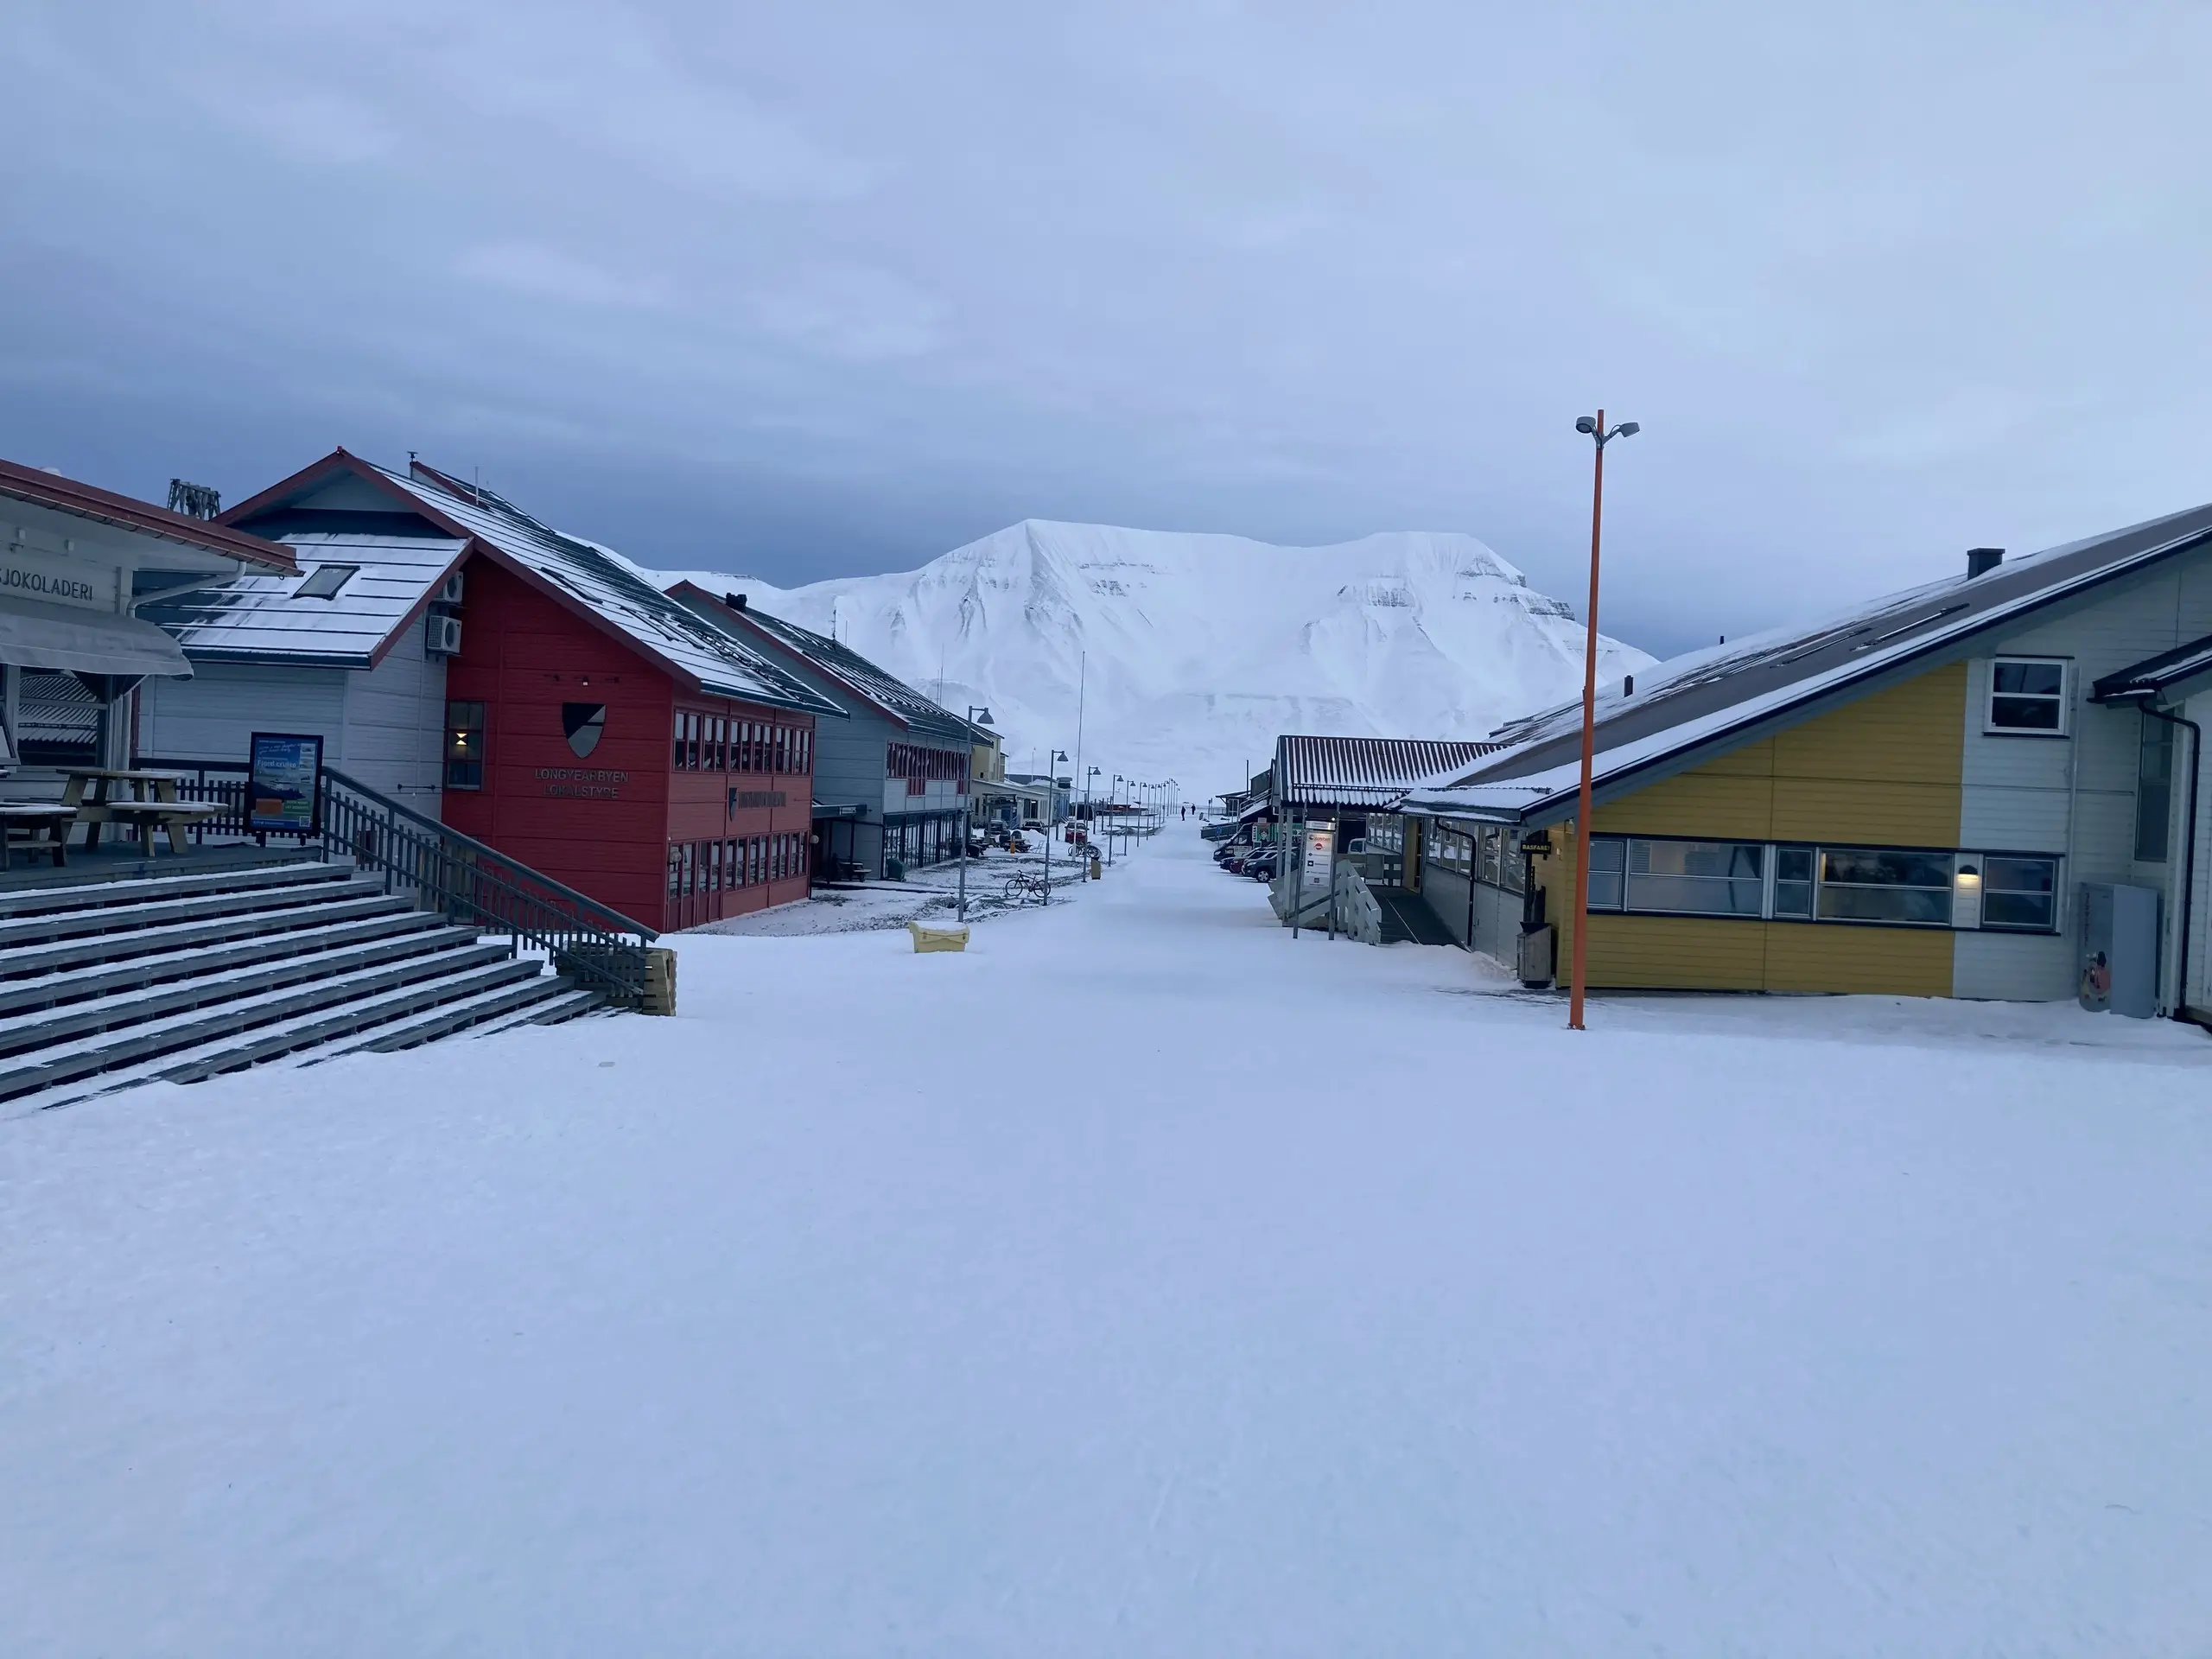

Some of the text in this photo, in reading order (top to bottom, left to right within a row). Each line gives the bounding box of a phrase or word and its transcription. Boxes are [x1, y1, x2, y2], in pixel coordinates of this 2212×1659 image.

[0, 568, 92, 601] JOKOLADERI
[535, 767, 629, 783] LONGYEARBYEN
[543, 784, 619, 798] LOKALSTYRE
